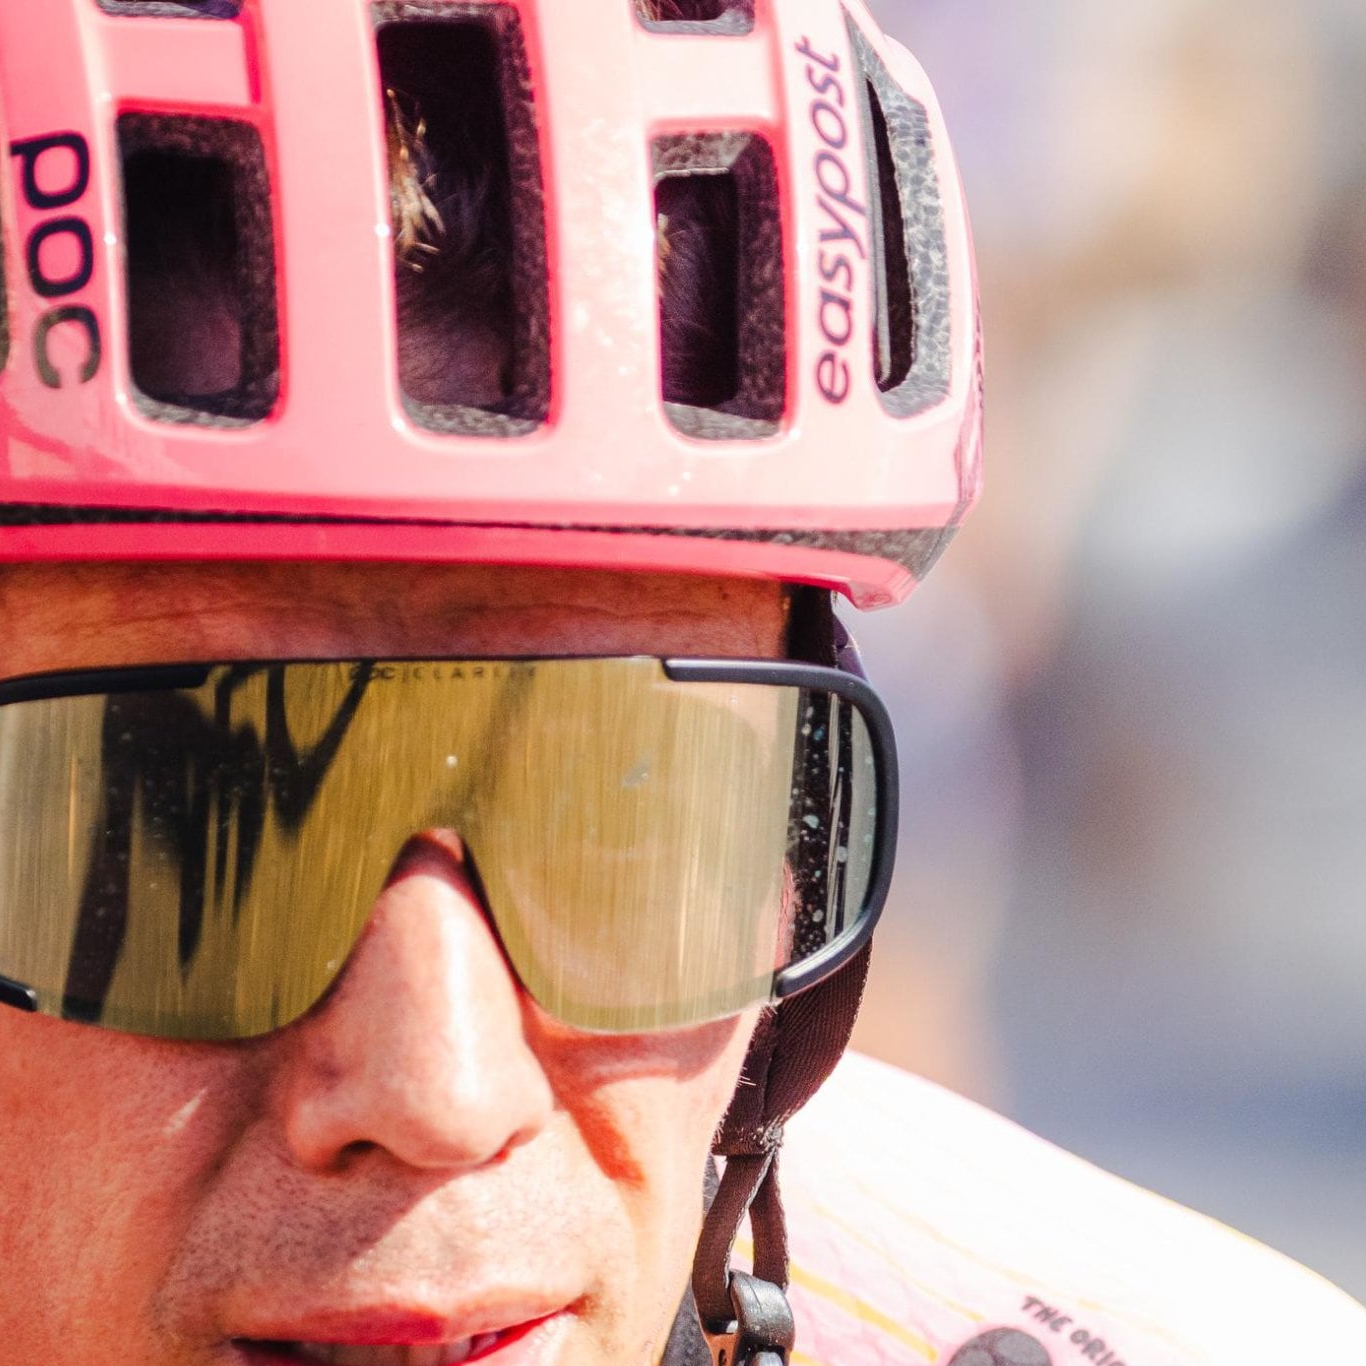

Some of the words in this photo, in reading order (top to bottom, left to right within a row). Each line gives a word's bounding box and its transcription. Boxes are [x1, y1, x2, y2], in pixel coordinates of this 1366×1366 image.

[9, 130, 101, 390] poc
[794, 36, 869, 405] easypost
[1021, 1295, 1074, 1333] THE
